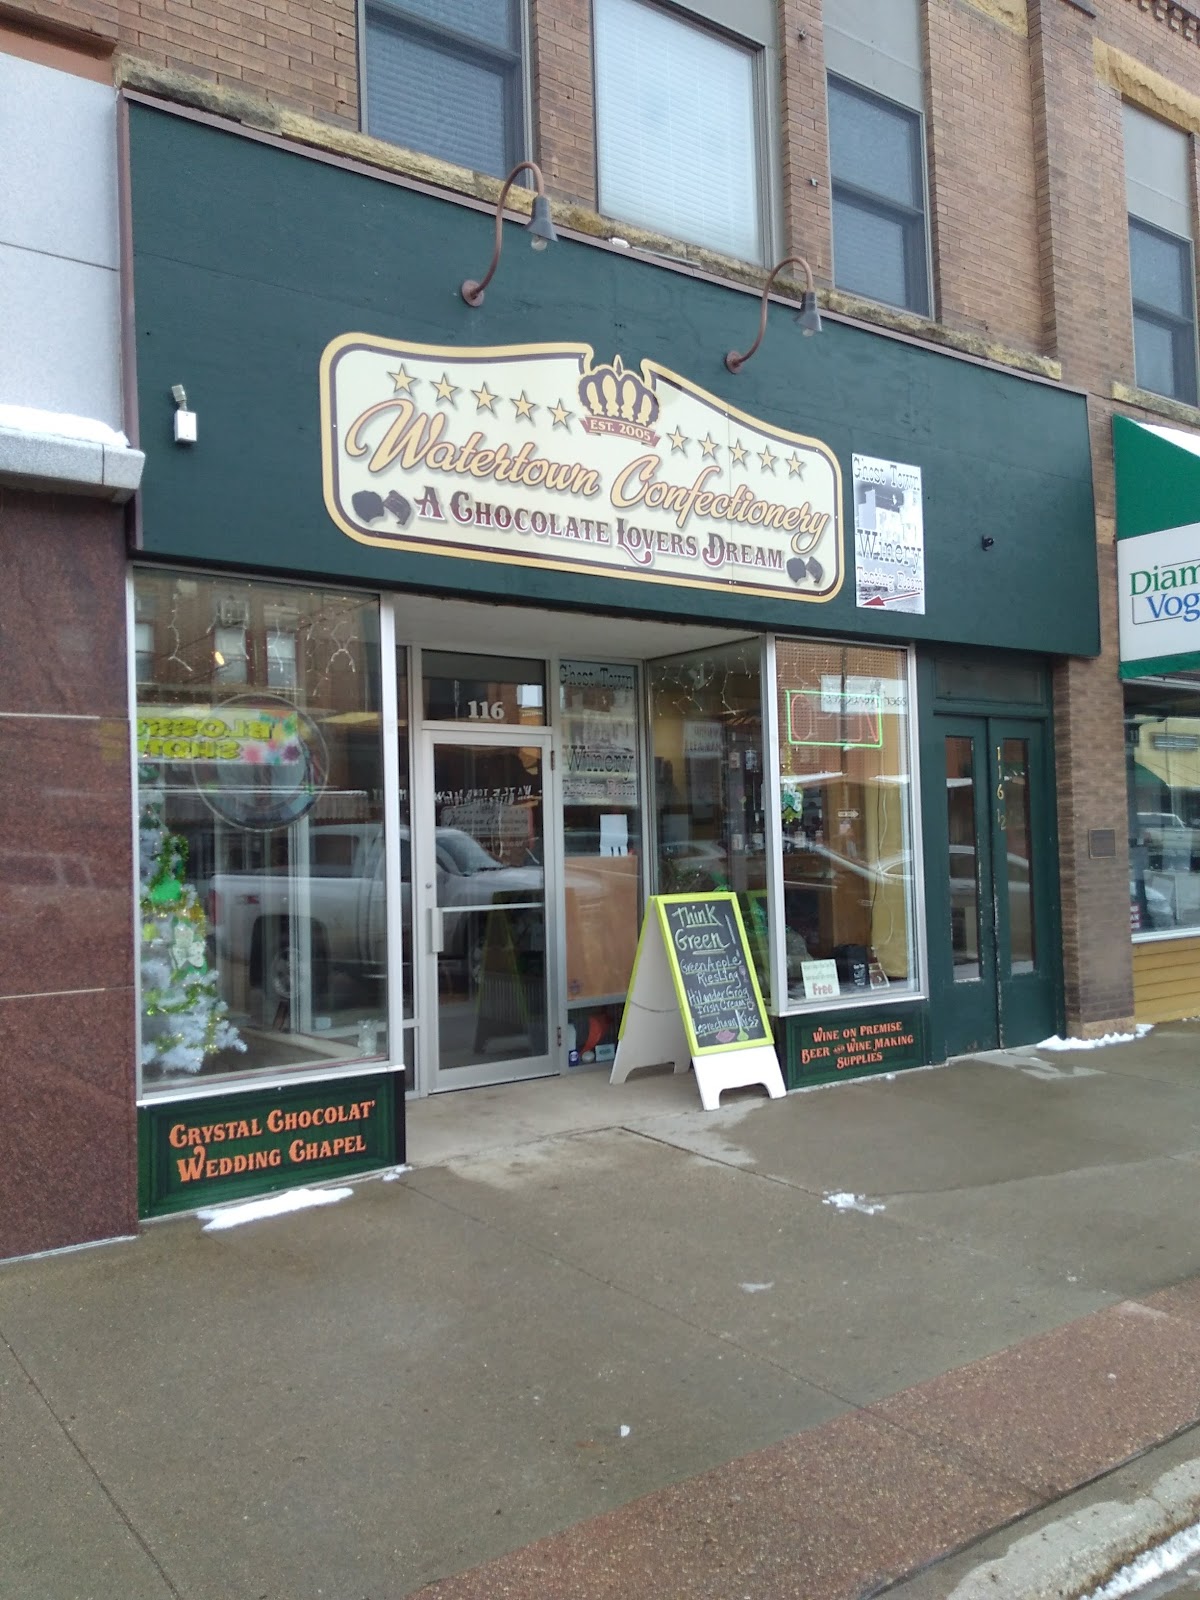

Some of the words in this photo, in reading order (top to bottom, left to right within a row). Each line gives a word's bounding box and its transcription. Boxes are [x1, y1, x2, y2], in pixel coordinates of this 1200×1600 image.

[590, 419, 615, 432] EST.
[619, 423, 651, 441] 2005
[345, 398, 600, 496] Watertown
[610, 454, 831, 555] Confectionery
[413, 485, 444, 520] A
[450, 490, 610, 544] CHOCOLATE
[616, 518, 698, 566] LOVERS
[702, 532, 784, 569] DREAM
[856, 529, 922, 575] Winery
[1145, 592, 1200, 623] Vog
[467, 700, 505, 720] 116
[561, 744, 635, 782] Winery
[672, 903, 724, 928] Think
[674, 928, 731, 951] Green
[812, 983, 834, 996] Free
[812, 1026, 840, 1043] WINE
[860, 1021, 903, 1037] PREMISE
[801, 1046, 831, 1064] BEER
[846, 1038, 871, 1053] WINE
[872, 1034, 914, 1051] MAKING
[836, 1052, 883, 1069] SUPPLIES
[169, 1118, 263, 1148] CRYSTAL
[176, 1145, 281, 1183] WEDDING
[288, 1135, 367, 1163] CHAPEL
